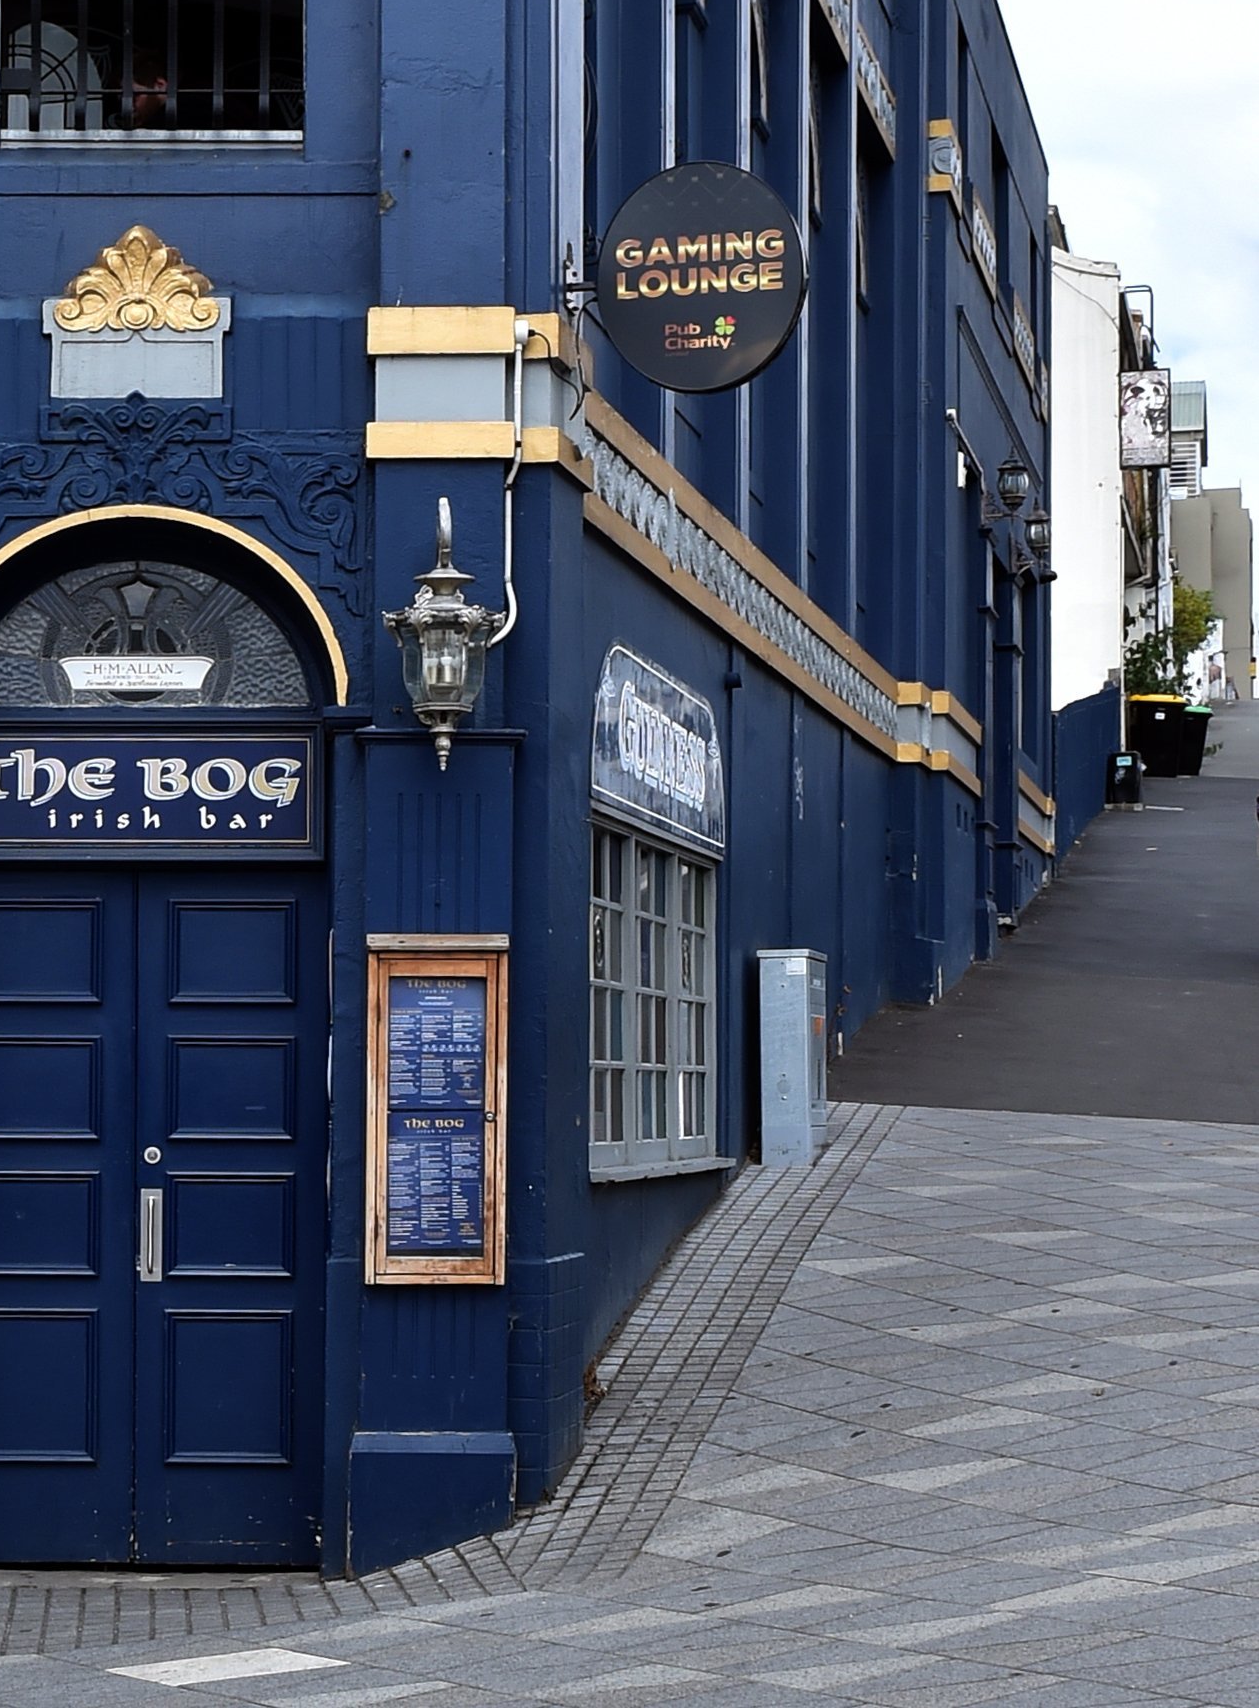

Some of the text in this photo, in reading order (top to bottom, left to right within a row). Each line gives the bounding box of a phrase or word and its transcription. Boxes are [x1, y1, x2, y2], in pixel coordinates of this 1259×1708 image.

[614, 228, 786, 268] GAMING
[616, 261, 785, 300] LOUNGE
[664, 323, 702, 336] Pub
[664, 334, 733, 351] Charity
[48, 806, 274, 830] irish bar
